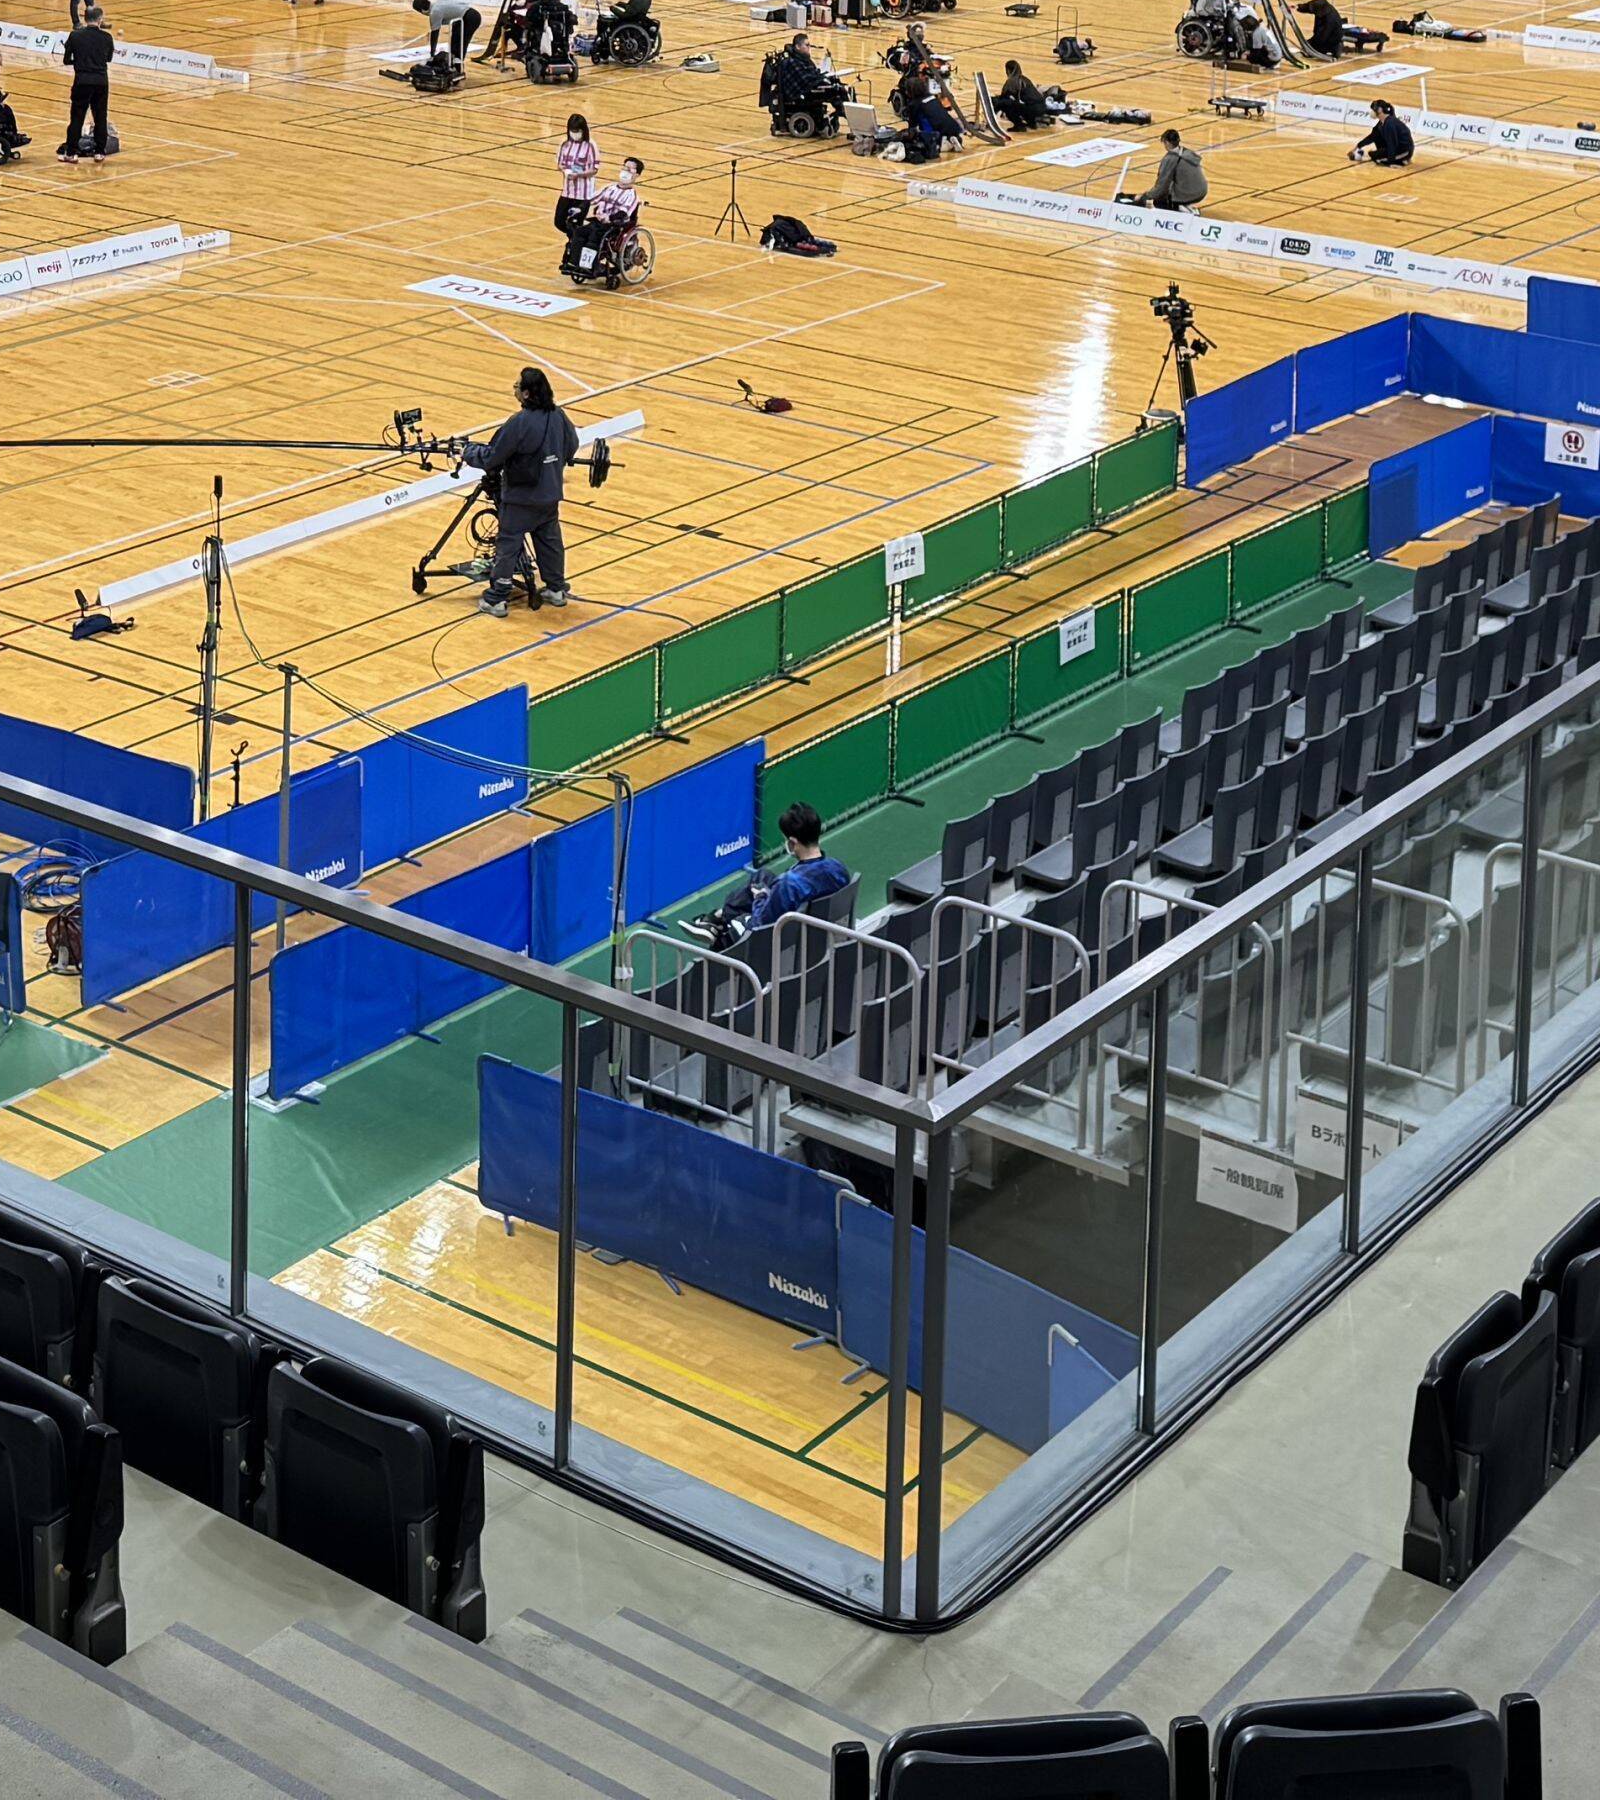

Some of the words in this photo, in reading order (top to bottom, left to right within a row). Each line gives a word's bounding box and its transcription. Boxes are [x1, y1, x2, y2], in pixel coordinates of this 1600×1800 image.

[1459, 123, 1486, 135] NEC
[961, 187, 989, 199] TOYOTA
[1077, 206, 1103, 219] meiji
[1154, 218, 1183, 233] NEC
[1200, 225, 1222, 239] JR
[37, 259, 62, 275] meiji
[150, 236, 179, 249] TOYOTA
[439, 281, 552, 309] TOYOTA
[478, 776, 515, 800] Nittaku
[715, 834, 750, 859] Nittaku
[304, 857, 346, 883] Nittaku
[1211, 1165, 1285, 1200] 一般観覧席
[768, 1271, 829, 1310] Nittaku
